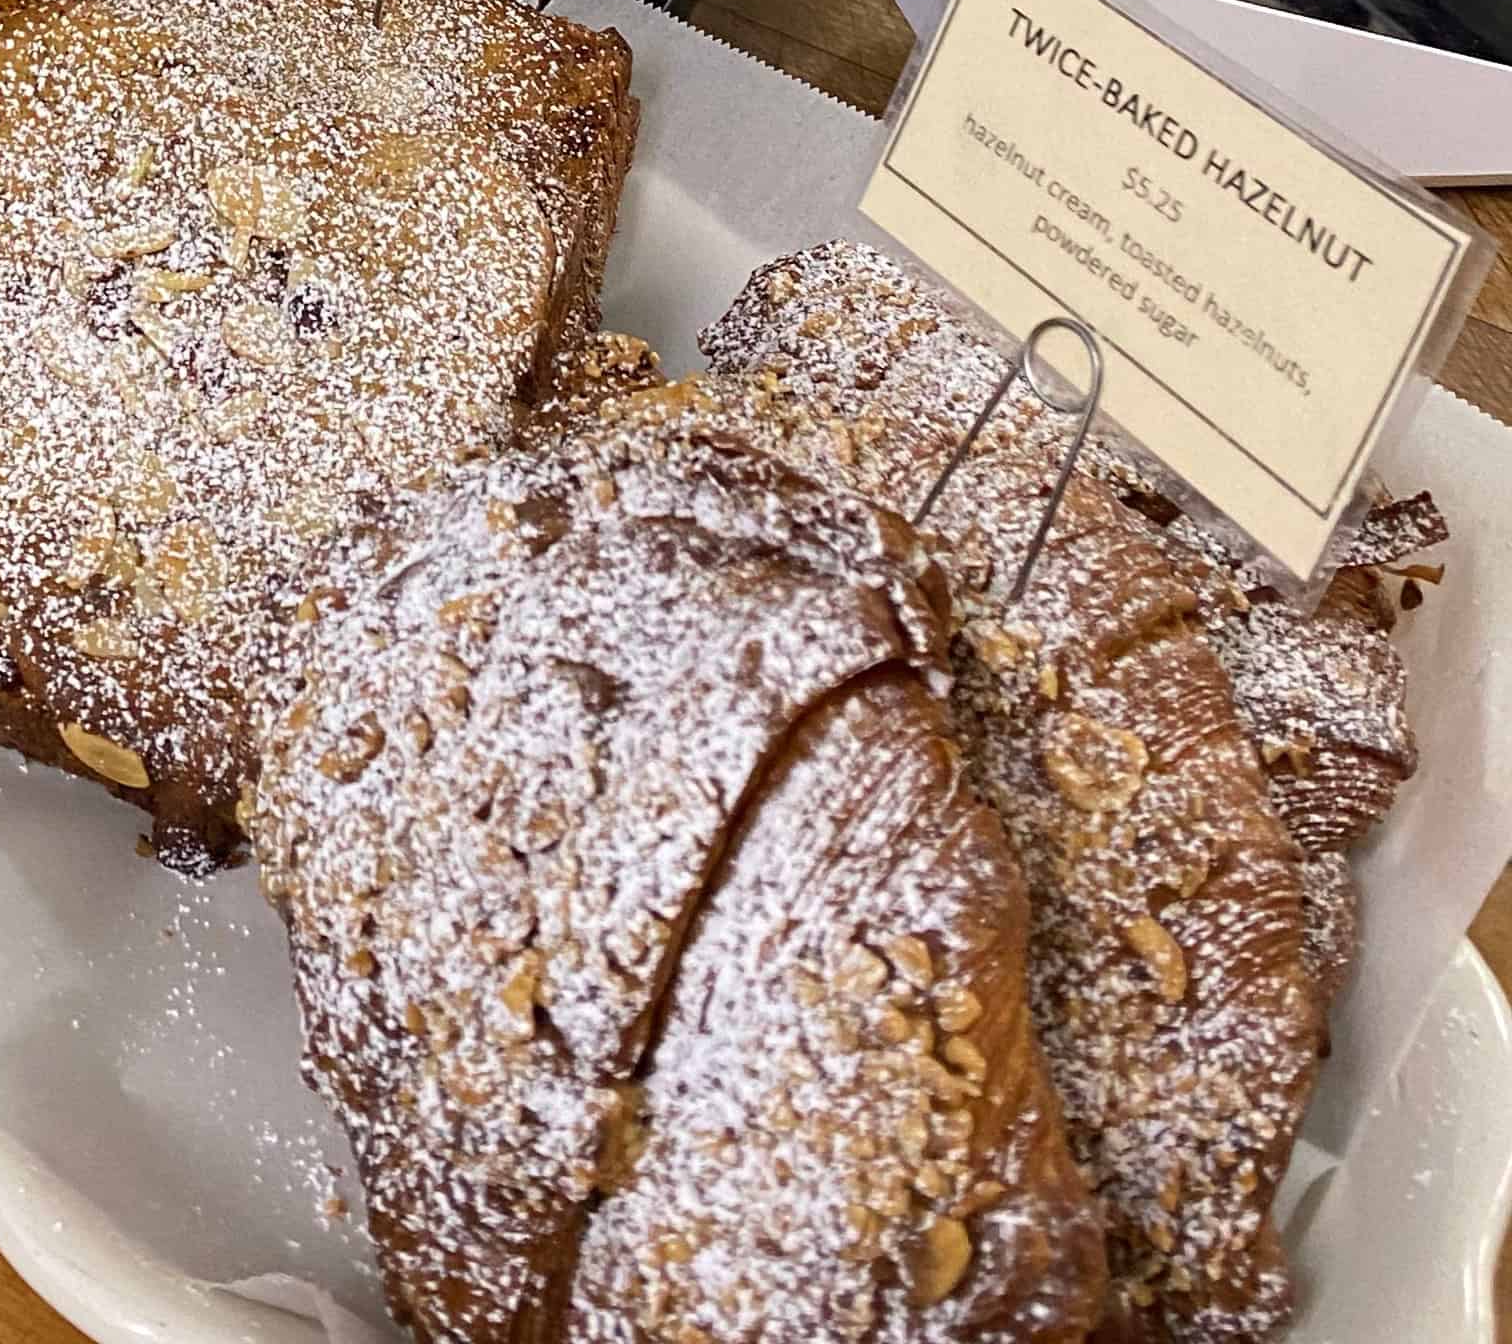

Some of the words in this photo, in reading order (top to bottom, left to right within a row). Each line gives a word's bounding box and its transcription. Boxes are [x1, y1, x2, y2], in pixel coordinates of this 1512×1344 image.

[1006, 8, 1201, 162] TWICE-BAKED
[1201, 146, 1375, 286] HAZELNUT
[1121, 165, 1185, 225] $5.25
[961, 111, 1047, 189] hazelnut
[1046, 178, 1117, 243] cream,
[1119, 227, 1204, 307] toasted
[1201, 293, 1314, 396] hazelnuts,
[1031, 213, 1140, 303] powdered
[1137, 294, 1201, 352] sugar
